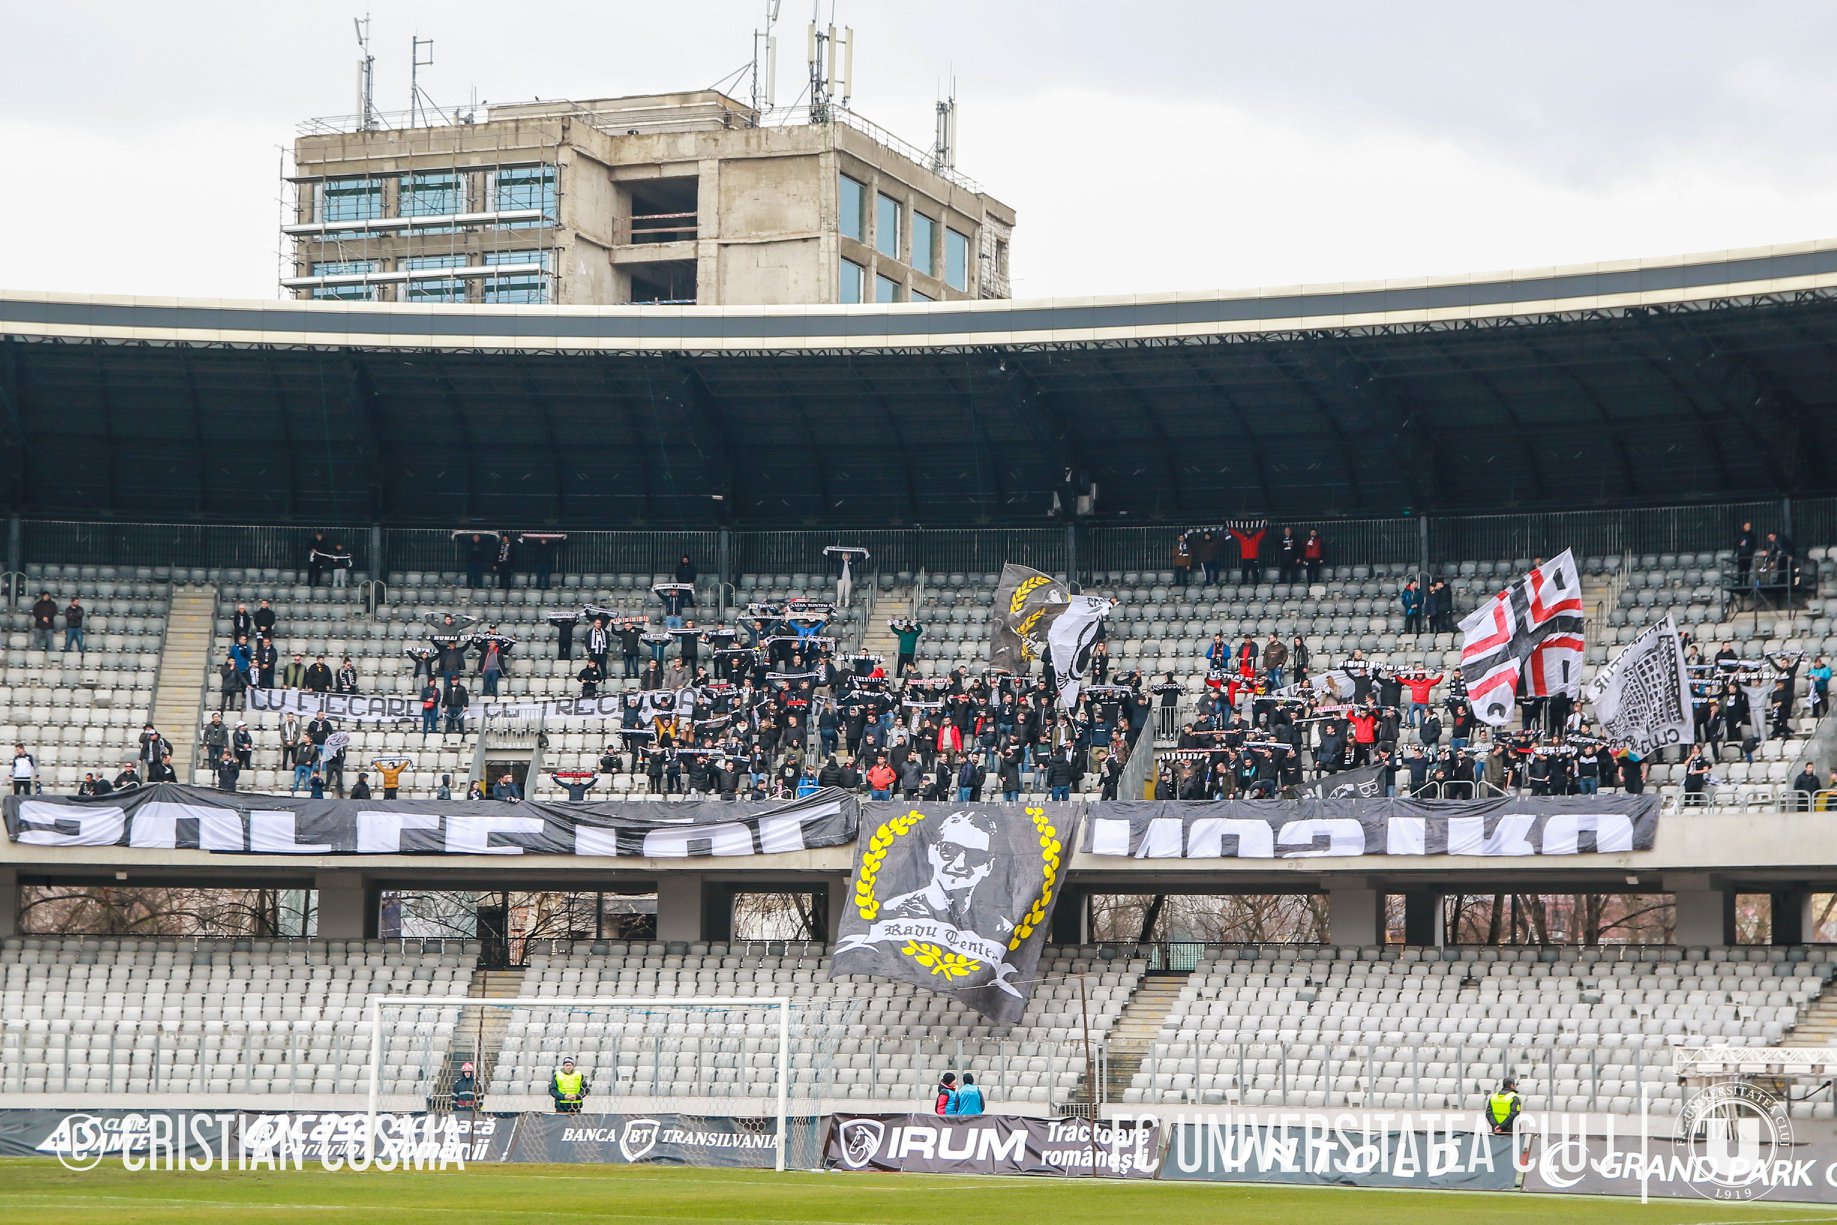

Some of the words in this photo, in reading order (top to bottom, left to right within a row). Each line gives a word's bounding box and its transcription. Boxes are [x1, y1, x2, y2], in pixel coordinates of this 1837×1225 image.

[884, 923, 938, 938] Radu
[561, 1127, 616, 1143] BANCA
[628, 1128, 653, 1144] BT
[661, 1129, 779, 1149] TRANSILVANIA
[886, 1125, 1029, 1162] IRUM
[1047, 1120, 1150, 1148] Tractoare
[1599, 1151, 1719, 1184] GRAND
[1726, 1156, 1817, 1187] PARK
